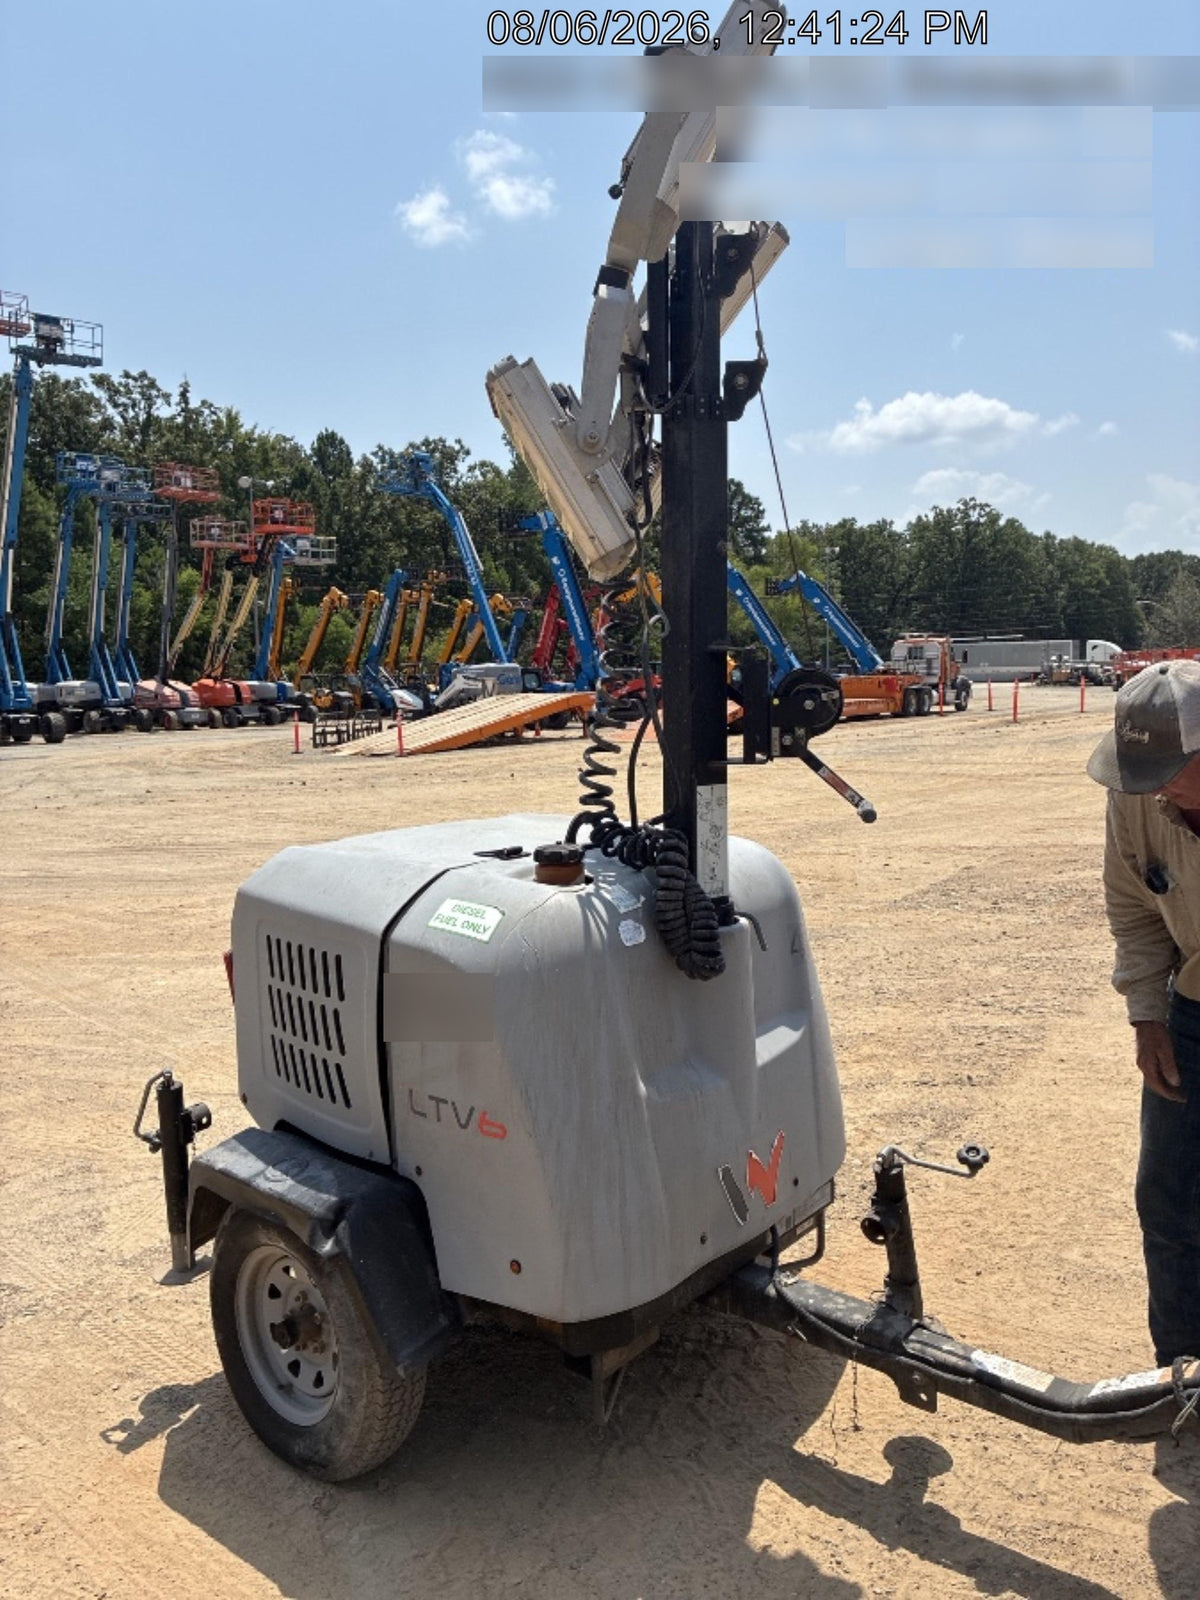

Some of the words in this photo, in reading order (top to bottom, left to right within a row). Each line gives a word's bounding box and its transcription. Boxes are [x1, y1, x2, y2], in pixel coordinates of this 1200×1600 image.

[451, 904, 487, 919] DIESEL
[434, 913, 459, 927] FUEL
[460, 920, 491, 934] ONLY
[408, 1088, 508, 1140] LTV6
